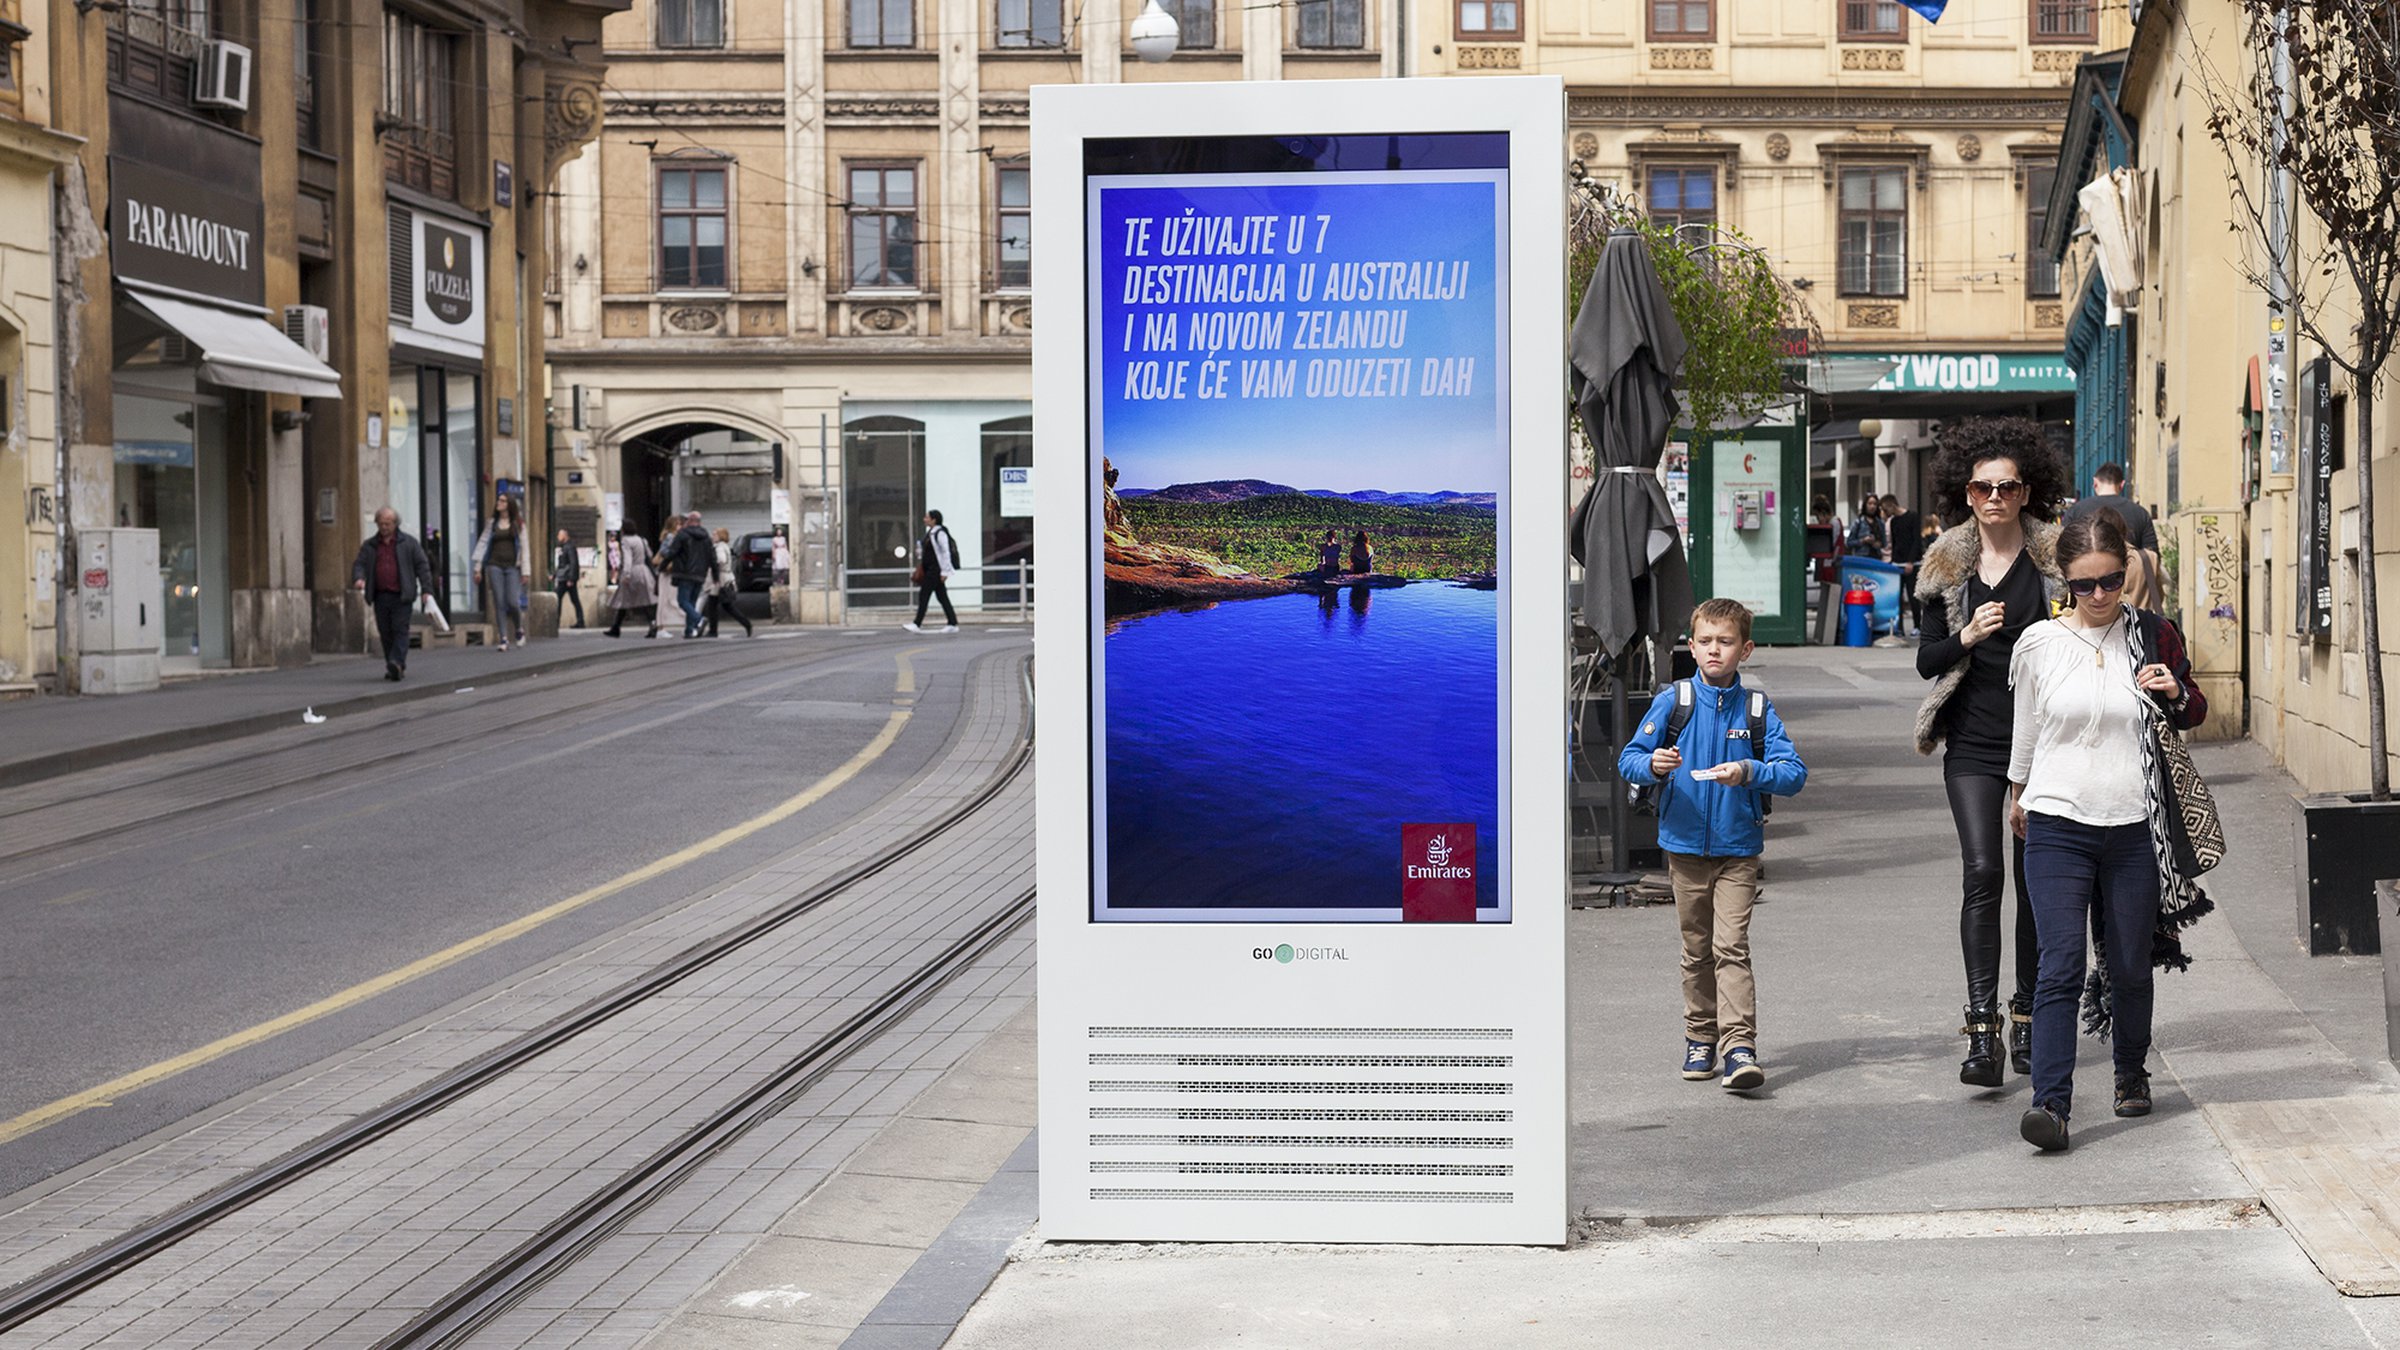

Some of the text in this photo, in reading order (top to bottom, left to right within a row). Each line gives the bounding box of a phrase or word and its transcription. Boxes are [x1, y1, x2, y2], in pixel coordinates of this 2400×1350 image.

[127, 198, 250, 271] PARAMOUNT
[1124, 207, 1331, 257] TE UŽIVAJTE U 7
[1123, 260, 1470, 305] DESTINACIJA U AUSTRALIJI
[1123, 309, 1408, 352] I NA NOVOM ZELANDU
[1123, 349, 1475, 400] KOJE ĆE VAM ODUZETI DAH
[2009, 366, 2063, 378] VANITY
[1727, 730, 1749, 739] FILA
[1407, 864, 1472, 879] Emirates
[1296, 947, 1349, 960] DIGITAL
